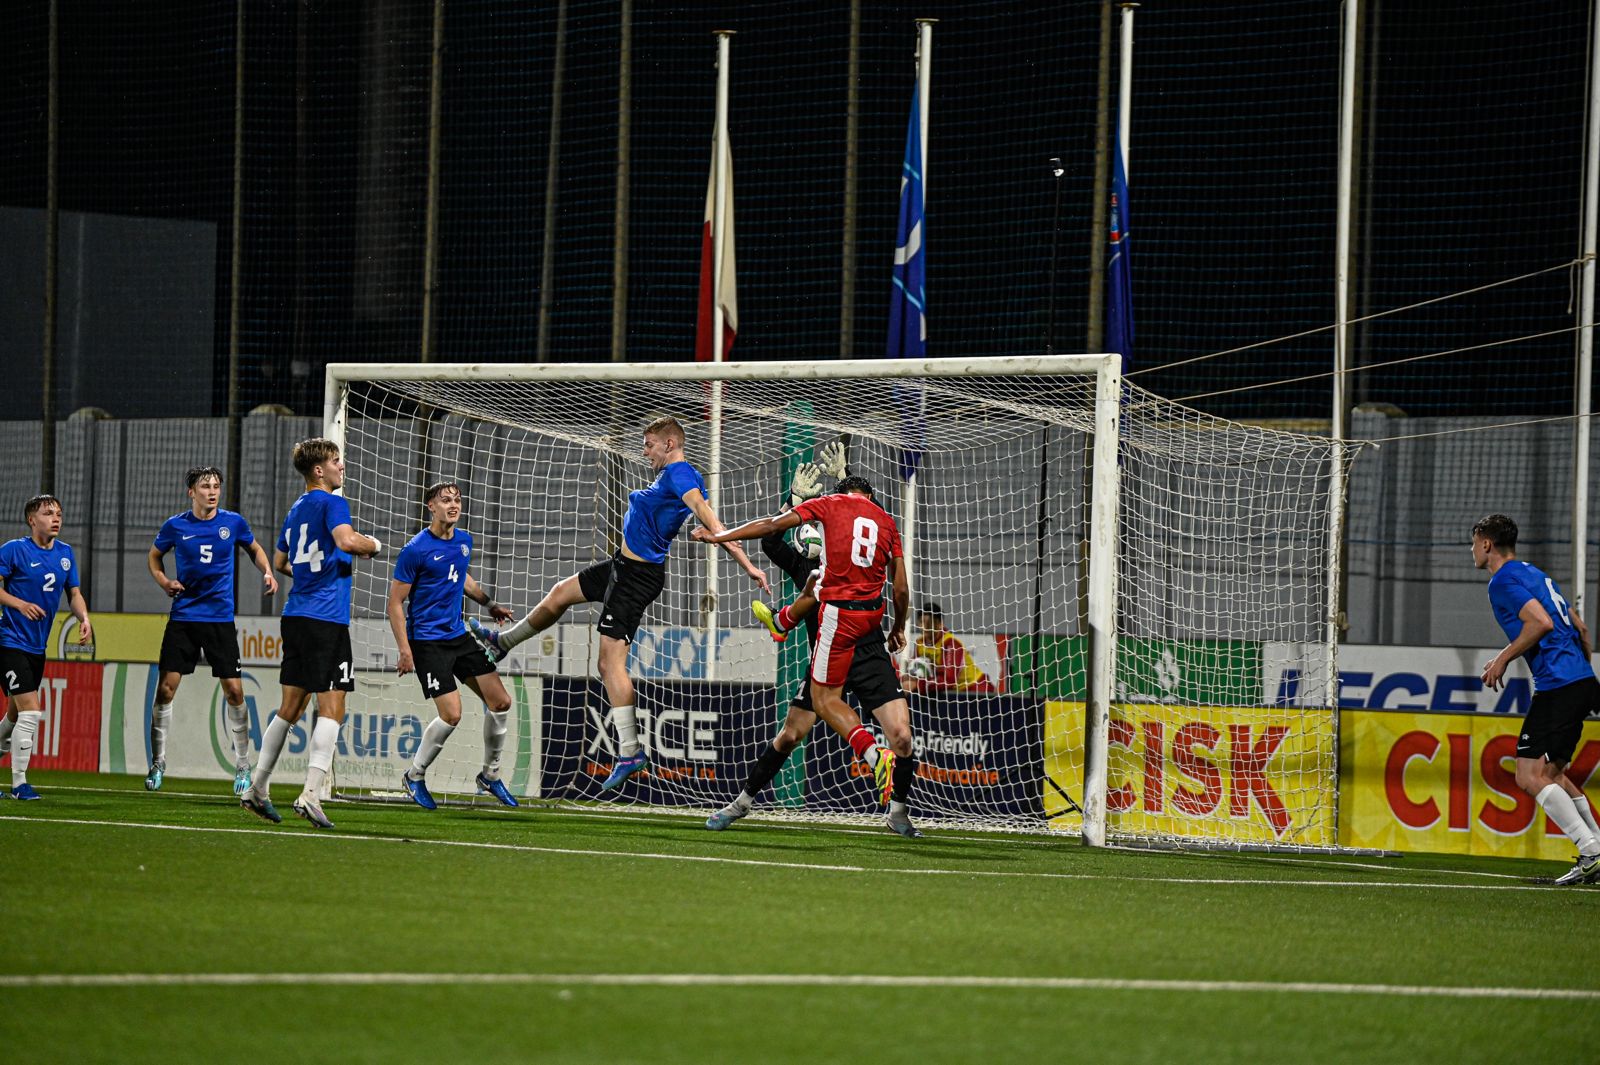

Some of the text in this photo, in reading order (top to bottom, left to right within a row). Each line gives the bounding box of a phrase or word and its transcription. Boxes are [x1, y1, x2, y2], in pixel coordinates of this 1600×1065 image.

[850, 516, 879, 568] 8
[199, 544, 213, 564] 5
[42, 572, 56, 592] 2
[447, 563, 459, 583] 4
[1544, 577, 1571, 626] 6
[5, 669, 20, 690] 2
[426, 672, 440, 691] 4
[793, 680, 807, 701] 1
[927, 730, 989, 761] Friendly
[1105, 719, 1293, 840] CISK
